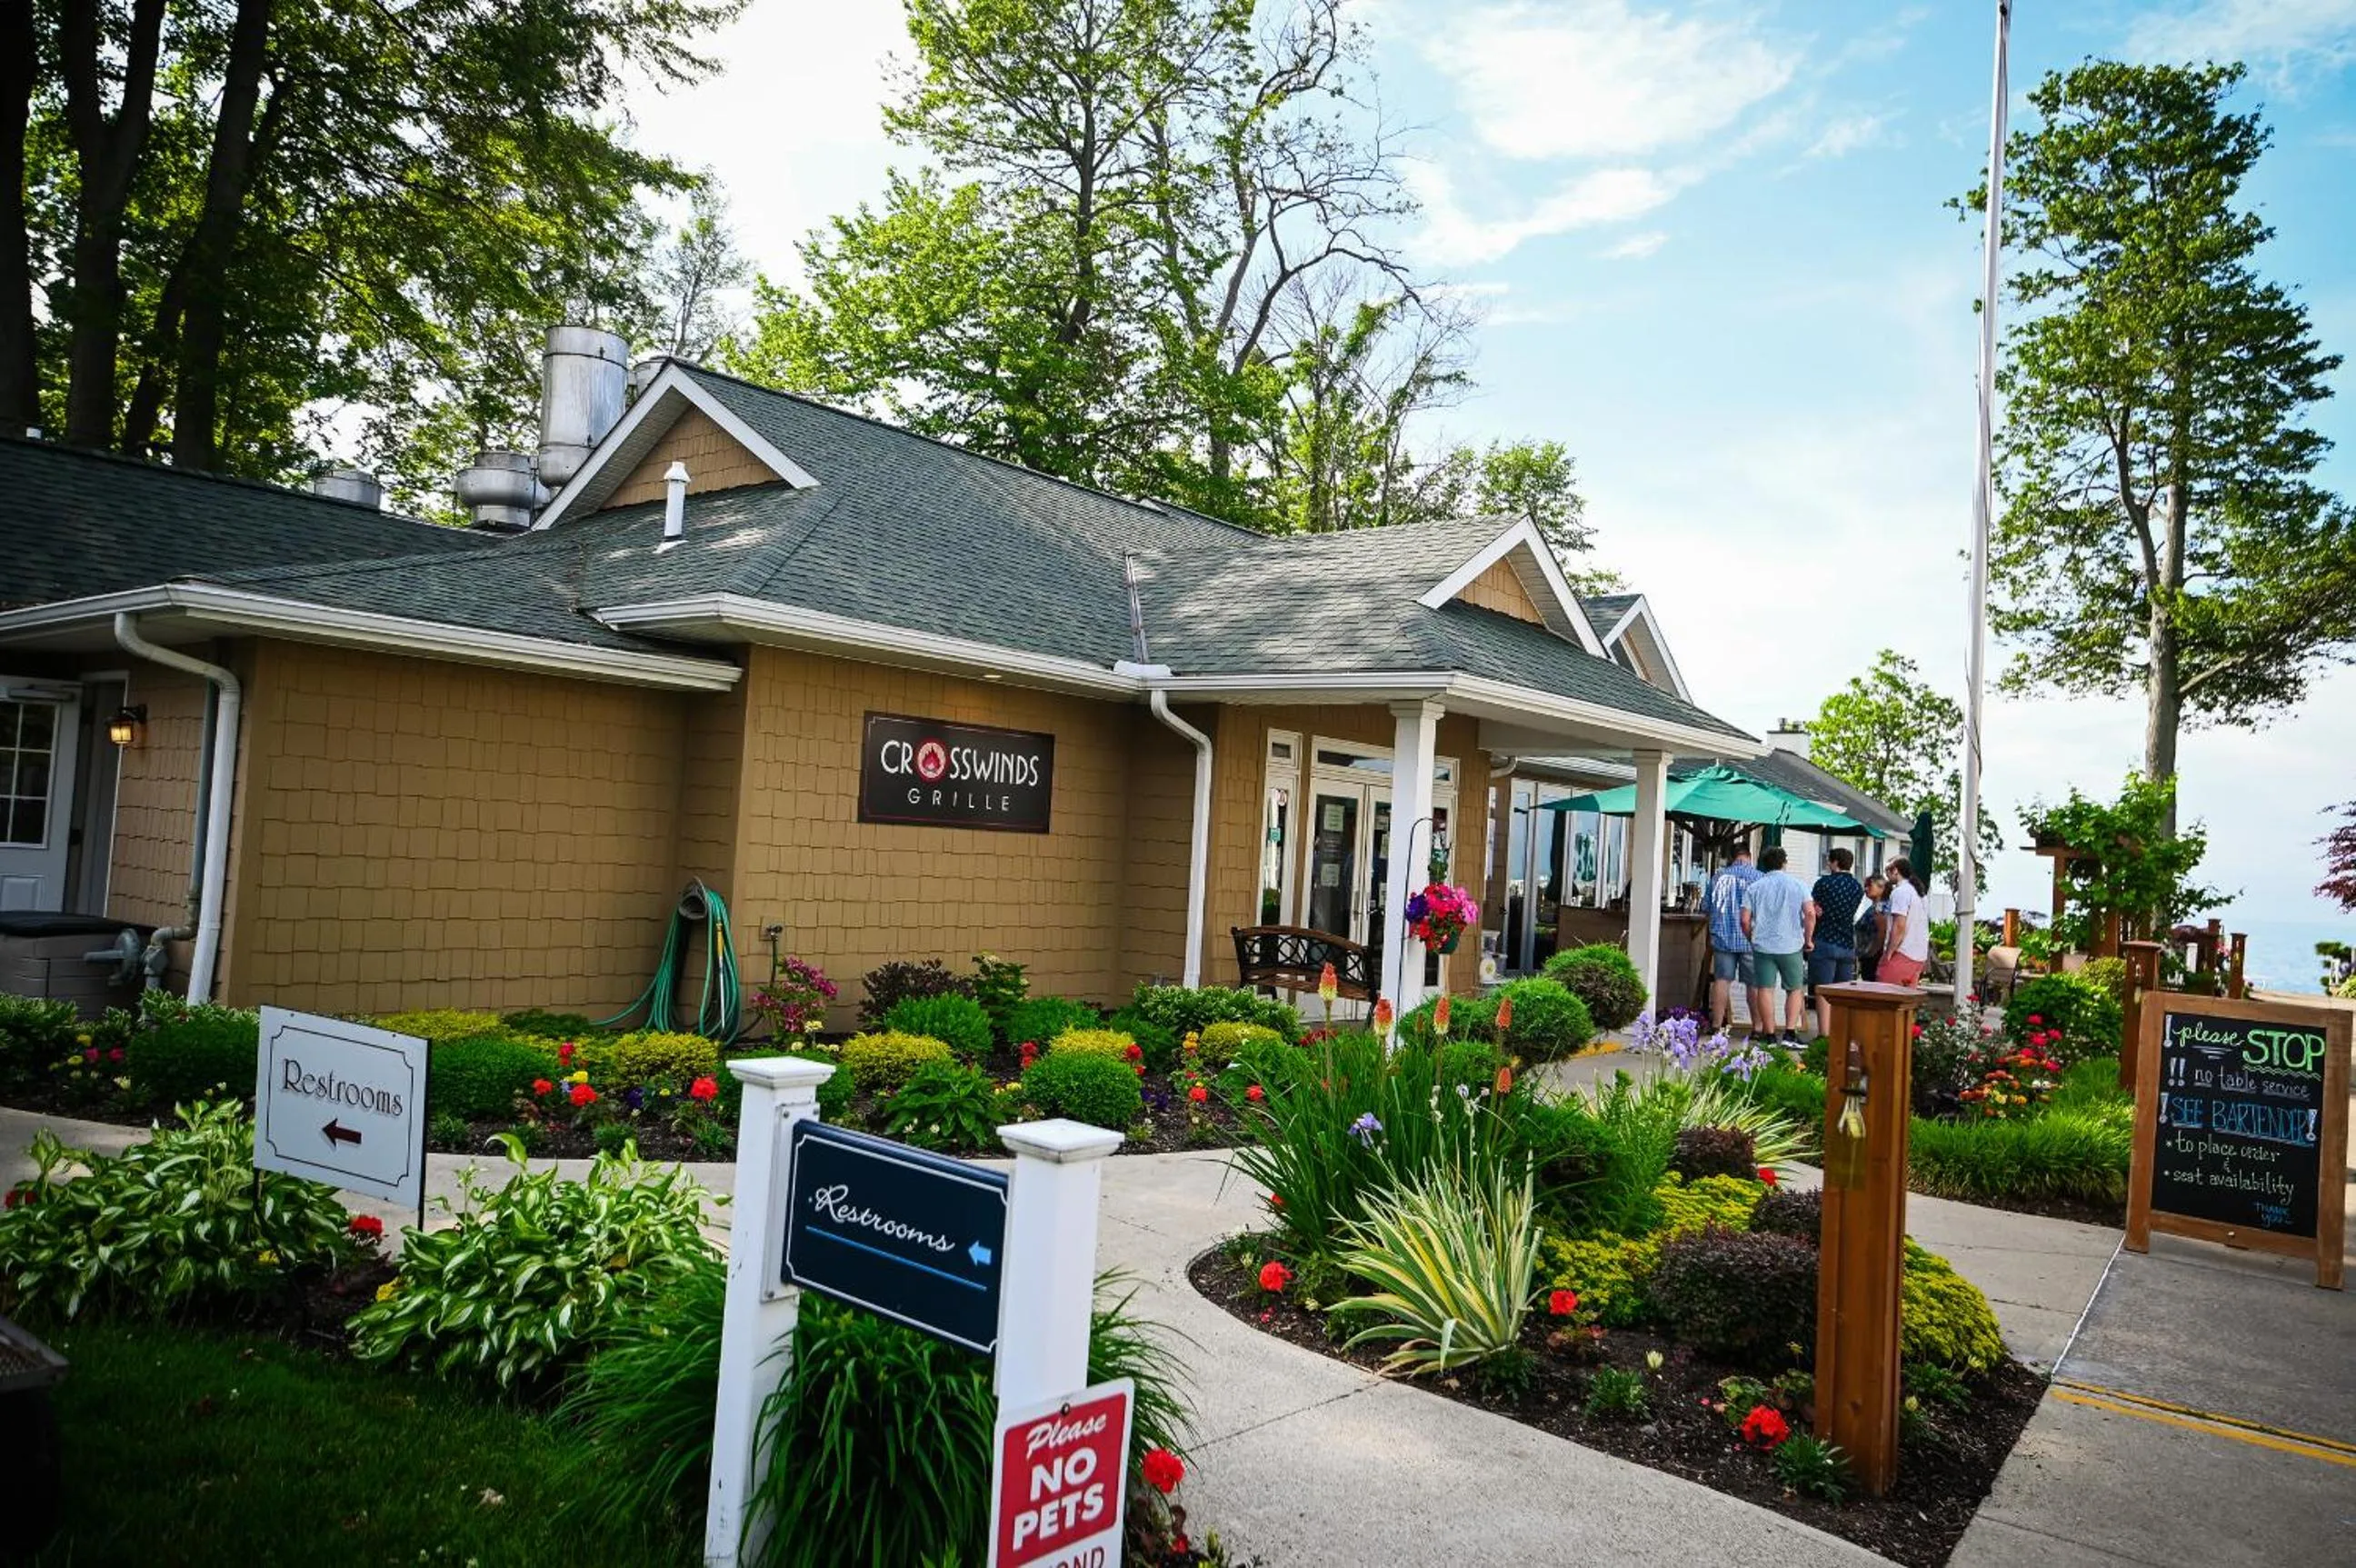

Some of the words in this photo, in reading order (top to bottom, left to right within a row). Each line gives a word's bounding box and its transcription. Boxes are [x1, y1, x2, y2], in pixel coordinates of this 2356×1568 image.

[881, 738, 1039, 786] CROSSWINDS
[907, 787, 1010, 812] GRILLE
[2172, 1022, 2244, 1047] please
[2242, 1029, 2325, 1071] STOP
[282, 1059, 403, 1116] Restrooms
[2194, 1067, 2213, 1083] no
[2218, 1065, 2257, 1091] table
[2262, 1079, 2311, 1099] service
[2176, 1129, 2193, 1153] to
[2198, 1134, 2237, 1160] place
[2173, 1167, 2203, 1185] seat
[2209, 1169, 2294, 1204] availability
[814, 1184, 955, 1252] Restrooms
[1025, 1413, 1106, 1461] Please
[1030, 1447, 1097, 1502] NO
[1013, 1483, 1104, 1552] PETS
